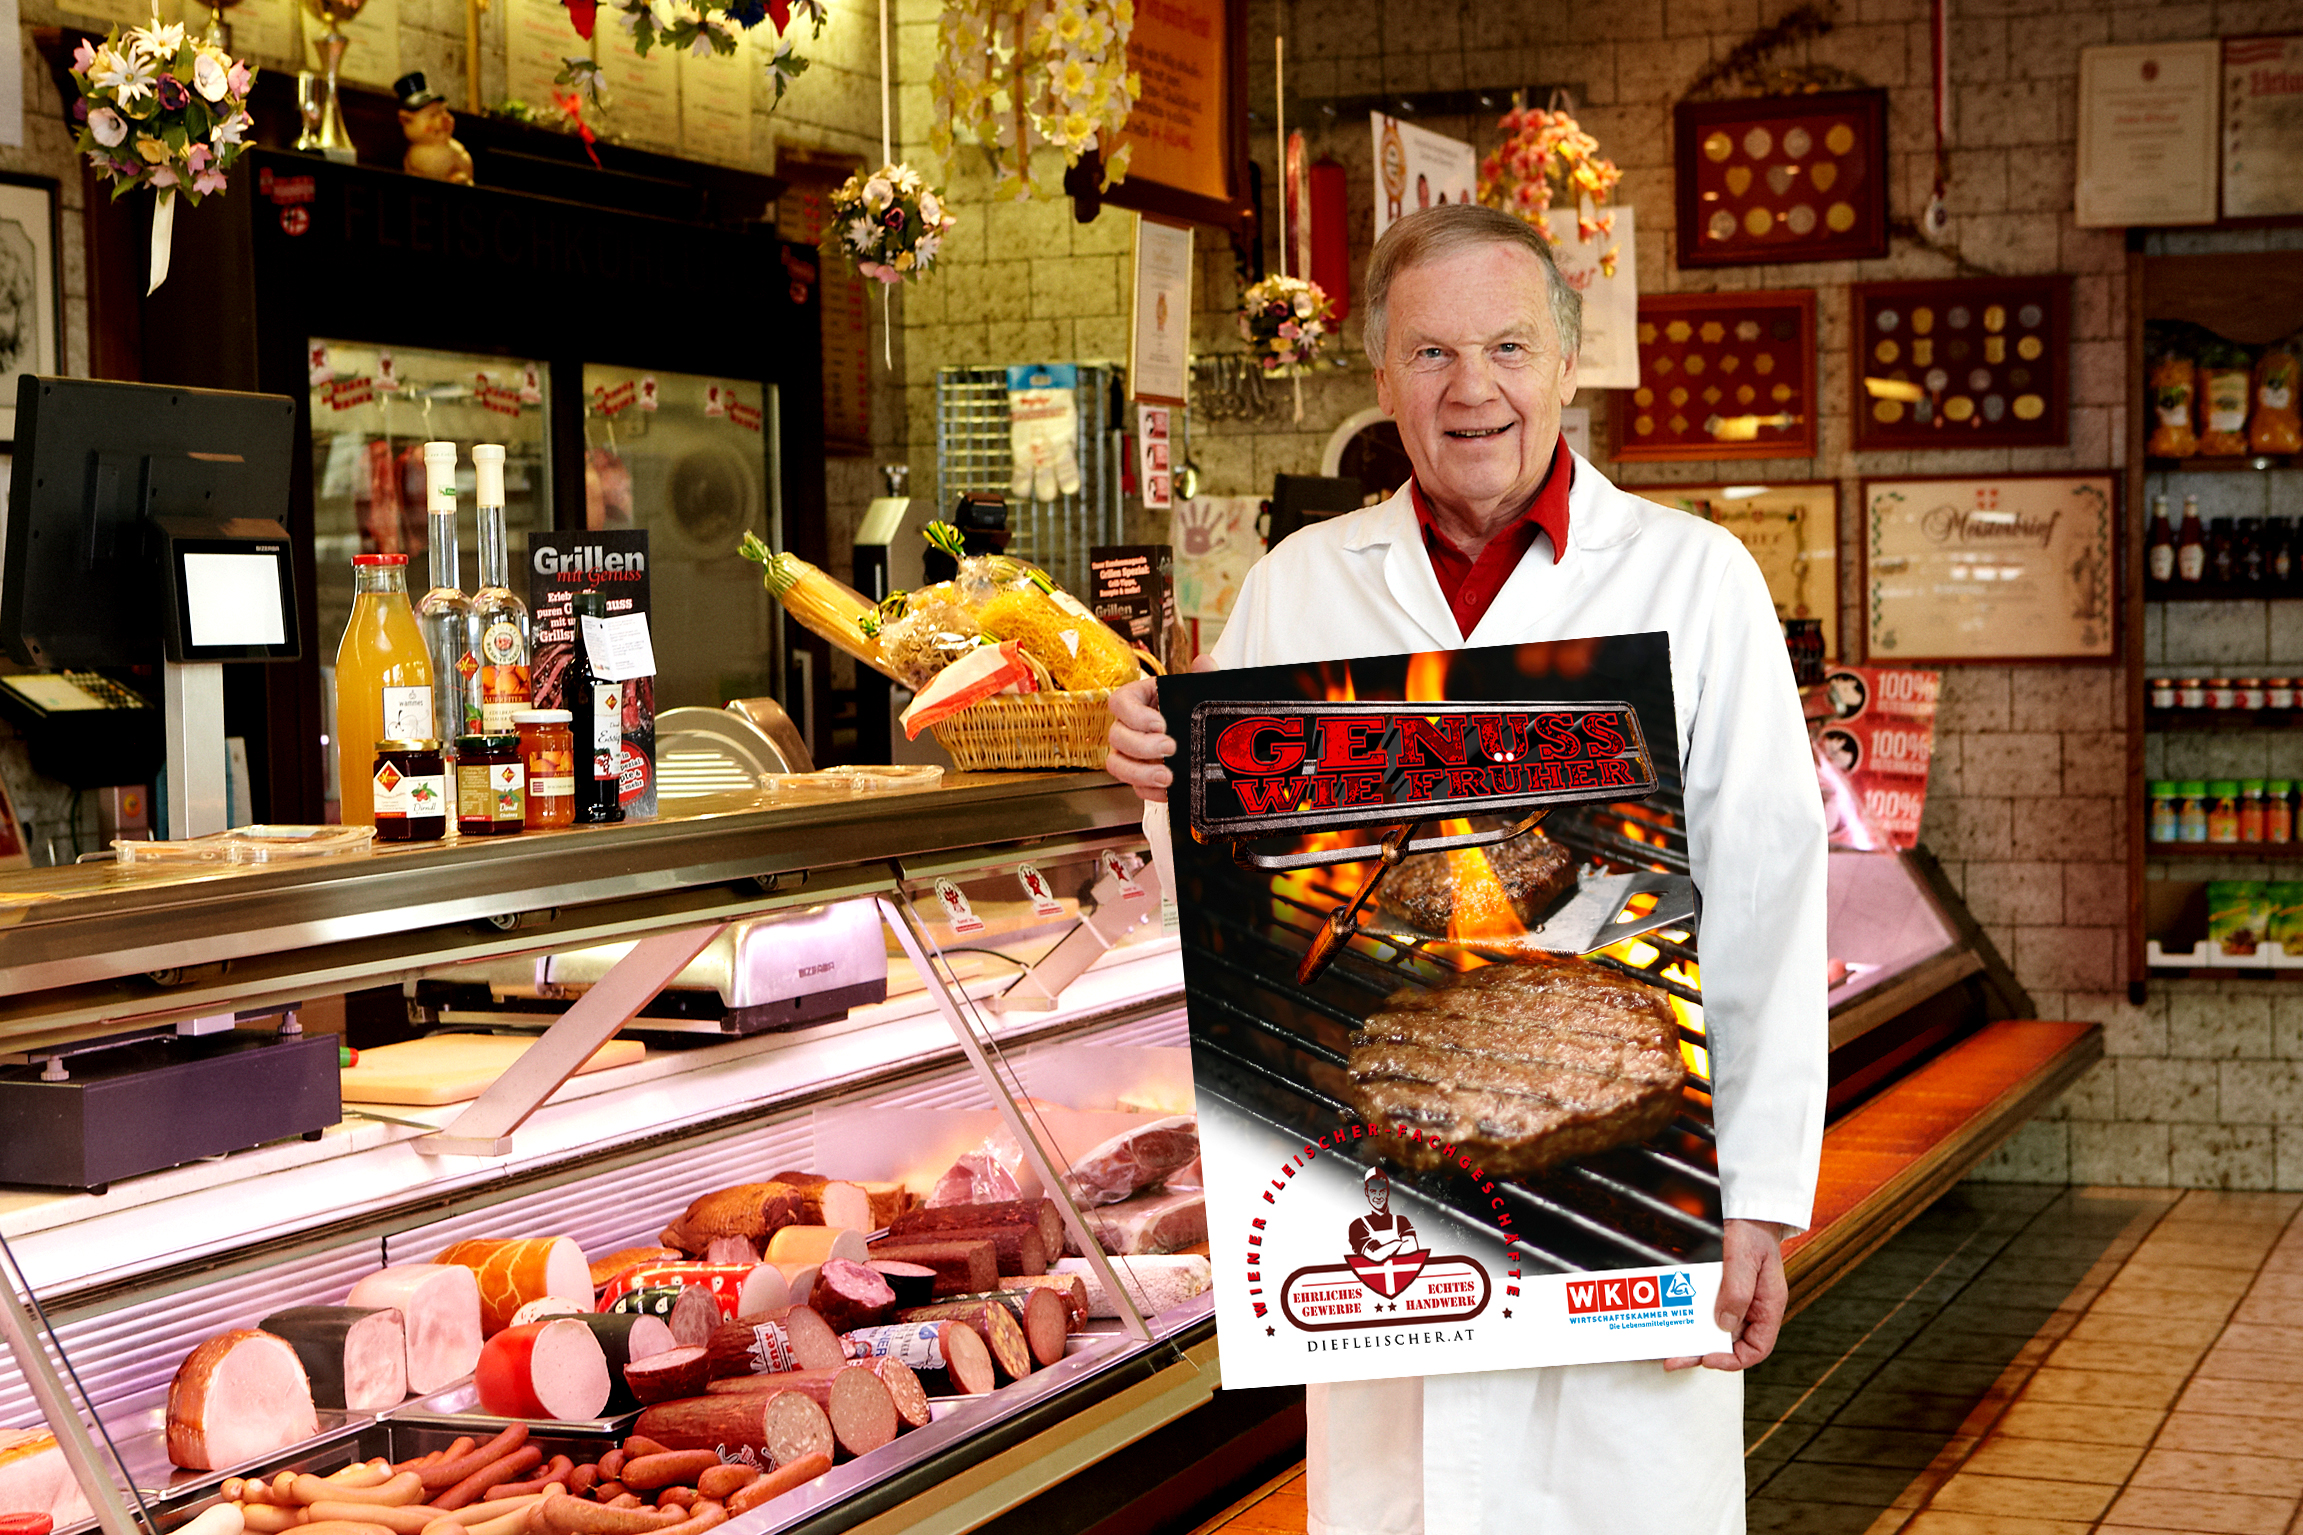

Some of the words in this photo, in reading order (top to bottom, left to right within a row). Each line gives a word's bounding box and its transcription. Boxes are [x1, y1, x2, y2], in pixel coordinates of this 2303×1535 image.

[533, 545, 645, 575] Grillen
[556, 567, 583, 583] mit
[587, 566, 642, 588] Genuss
[550, 617, 567, 628] mit
[1095, 603, 1132, 619] Grillen
[1216, 712, 1627, 776] GENUSS
[1871, 729, 1931, 761] 100%
[620, 758, 642, 772] pezial:
[1231, 770, 1385, 816] WIE
[1247, 1217, 1268, 1318] WIENER
[1262, 1123, 1522, 1298] FLEISCHER-FACHGESCHÄFTE
[1293, 1288, 1363, 1303] EHRLICHES
[1427, 1281, 1475, 1295] ECHTES
[1568, 1281, 1656, 1309] WKO
[1301, 1303, 1362, 1318] GEWERBE
[1405, 1295, 1476, 1311] HANDWERK
[1569, 1311, 1668, 1324] WIRTSCHAFTSKAMMER
[1671, 1308, 1694, 1317] WIEN
[1621, 1318, 1695, 1329] Lebensmittelgewerbe
[1307, 1329, 1475, 1352] DIEFLEISCHER.AT
